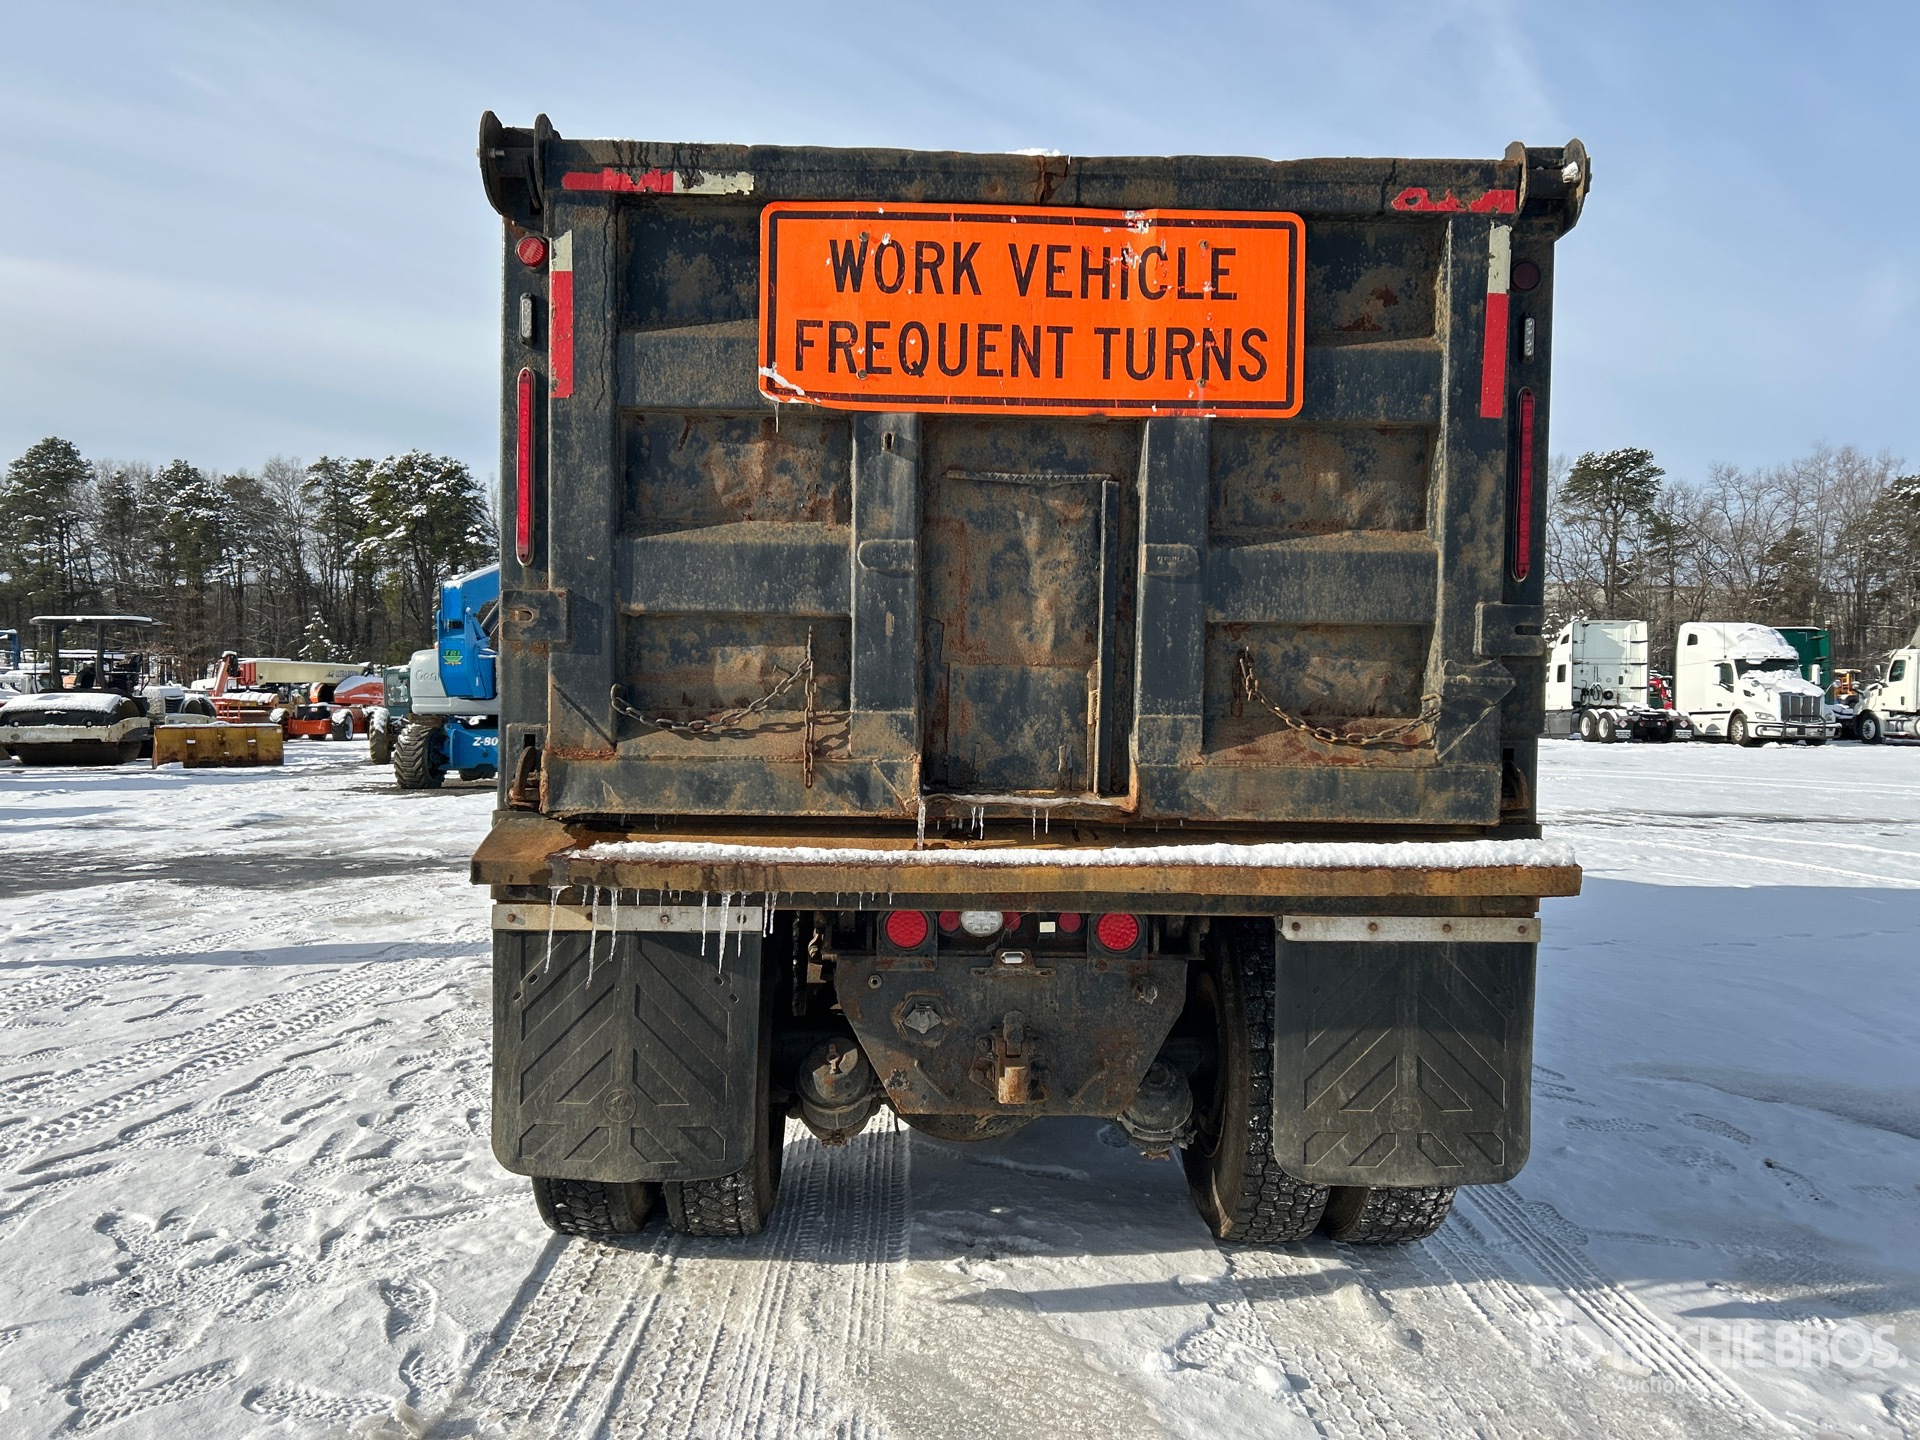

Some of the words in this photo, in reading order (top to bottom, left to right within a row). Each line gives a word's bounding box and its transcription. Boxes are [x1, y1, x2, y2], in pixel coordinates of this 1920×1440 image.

[828, 239, 982, 296] WORK
[1009, 243, 1238, 301] VEHICLE
[794, 319, 1073, 377] FREQUENT
[1093, 327, 1269, 382] TURNS
[472, 736, 499, 746] Z-80
